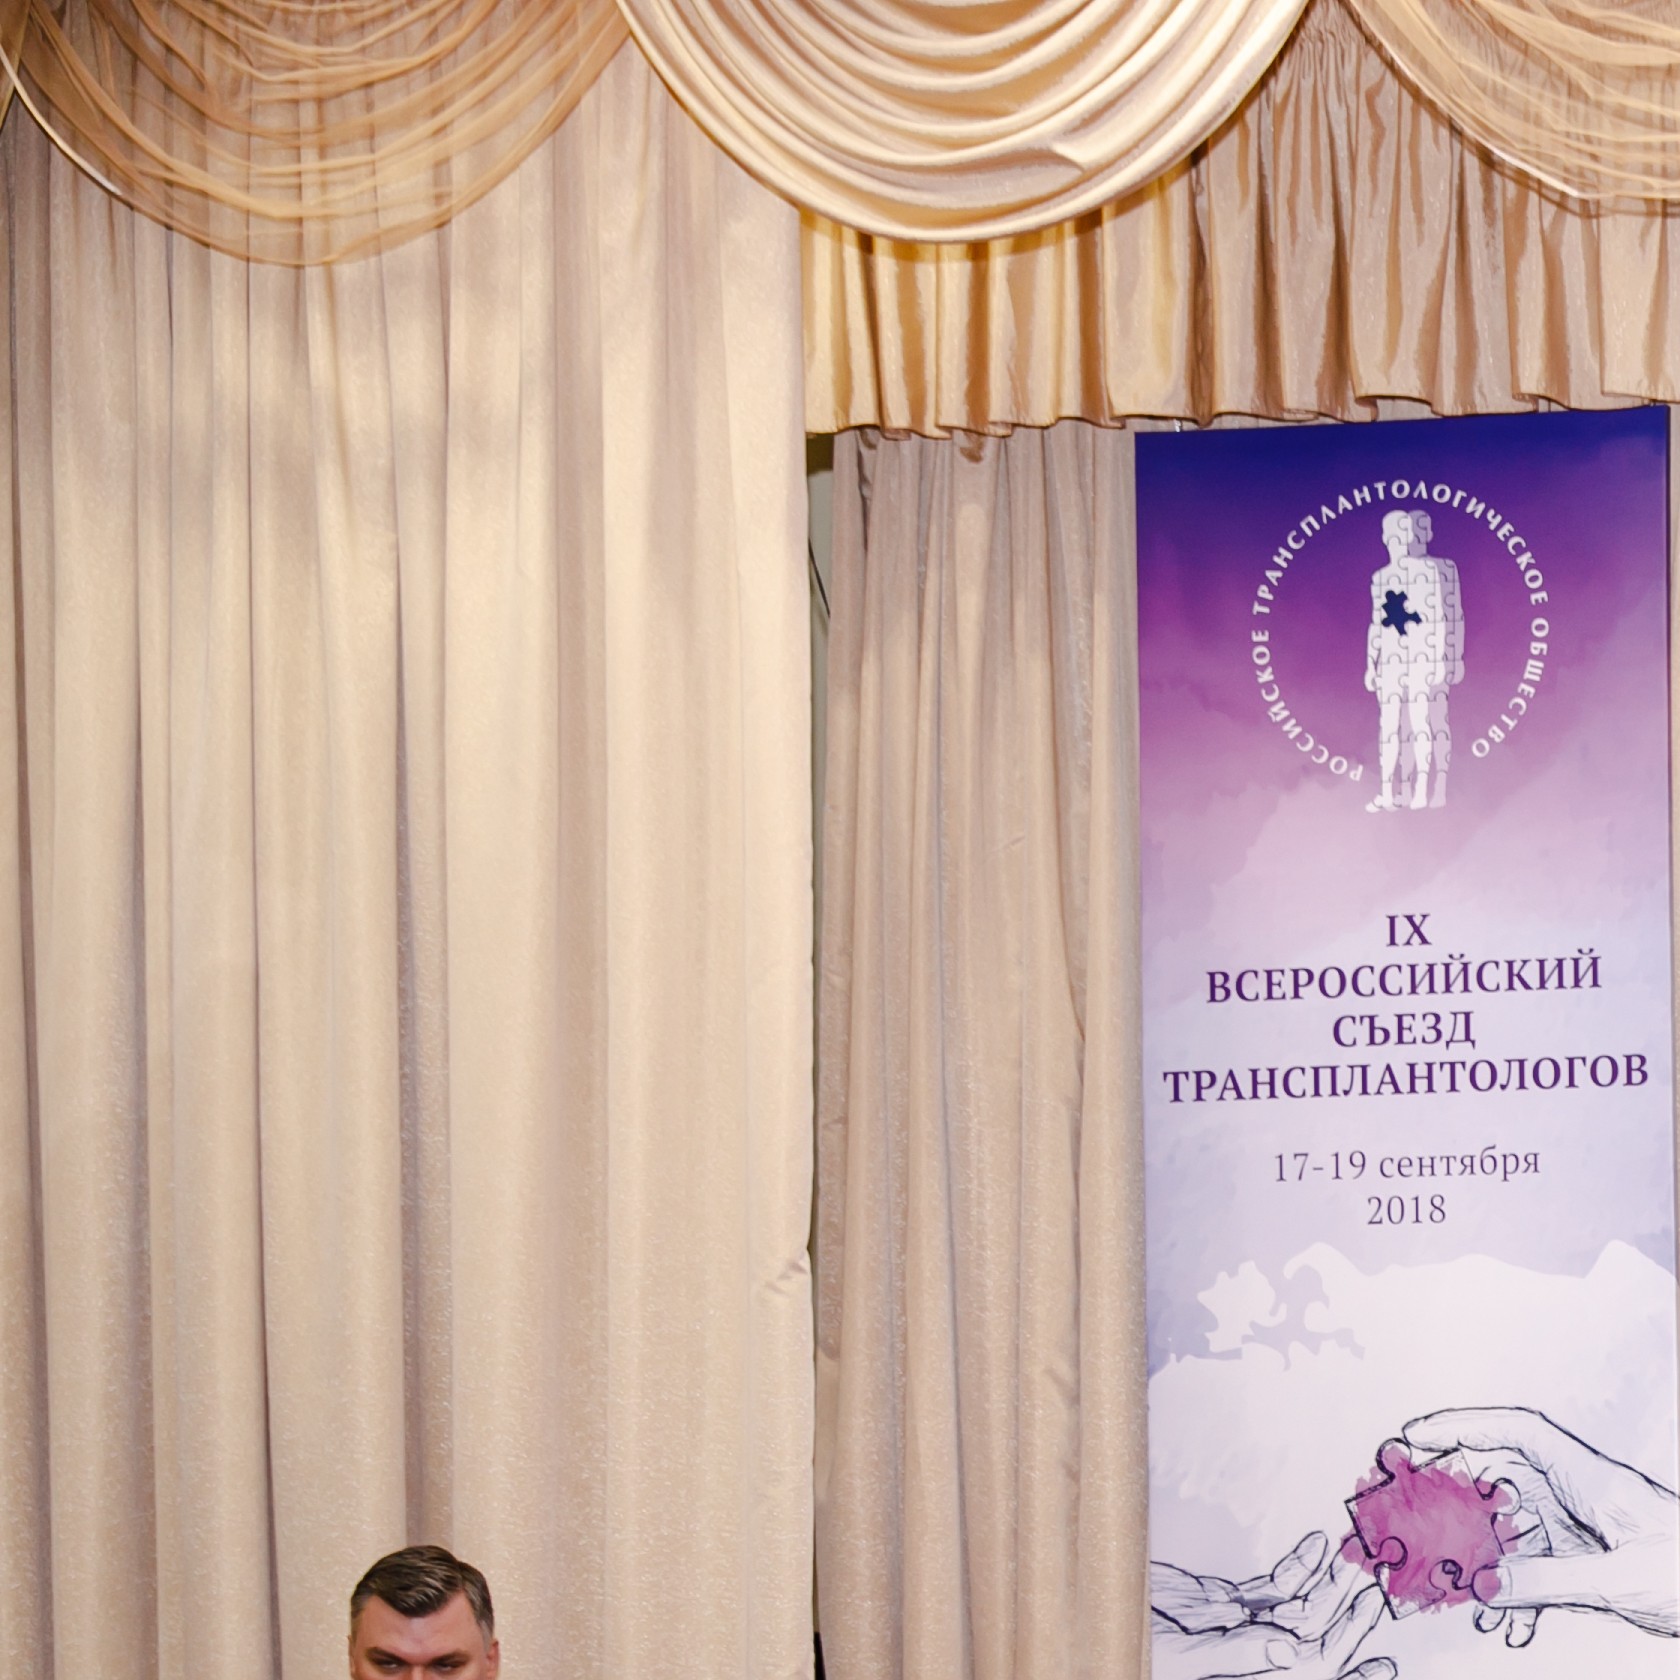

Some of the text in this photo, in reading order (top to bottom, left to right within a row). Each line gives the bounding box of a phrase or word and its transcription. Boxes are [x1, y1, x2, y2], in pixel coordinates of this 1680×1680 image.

[1252, 479, 1549, 782] РОССИЙСКОЕ ТРАНСПЛАНТОЛОГИЧЕСКОЕ ОБЩЕСТВО
[1385, 913, 1432, 947] IX
[1206, 948, 1602, 1004] ВСЕРОССИЙСКИЙ
[1332, 1011, 1476, 1050] СЪЕЗД
[1163, 1053, 1649, 1103] ТРАНСПЛАНТОЛОГОВ
[1275, 1145, 1540, 1182] 17-19 сентября
[1367, 1194, 1447, 1225] 2018
